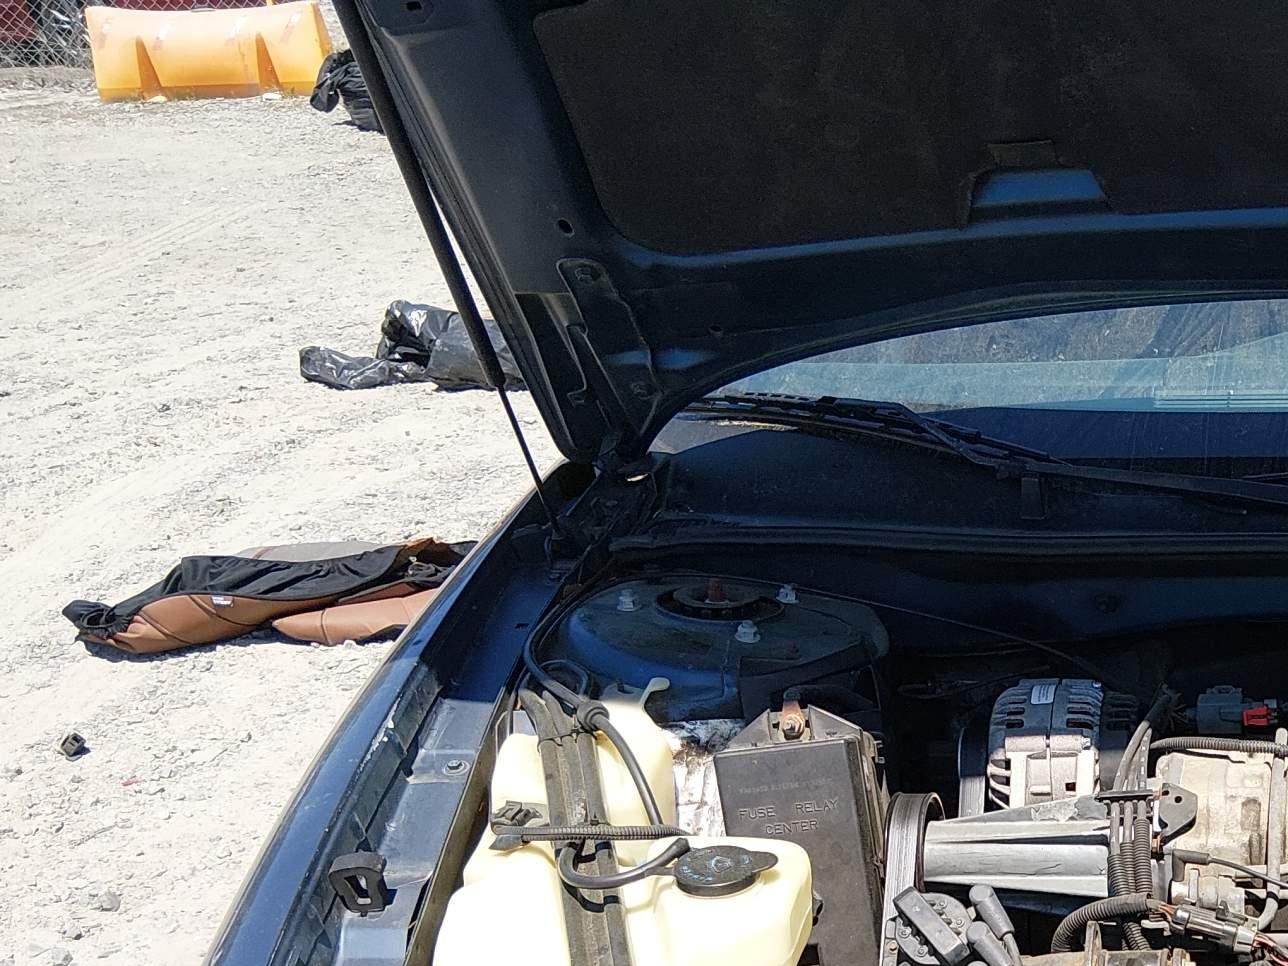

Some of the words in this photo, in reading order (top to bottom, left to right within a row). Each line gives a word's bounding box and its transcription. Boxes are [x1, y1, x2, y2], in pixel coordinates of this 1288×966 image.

[739, 805, 776, 820] FUSE
[795, 797, 838, 814] RELAY
[765, 819, 818, 835] CENTER
